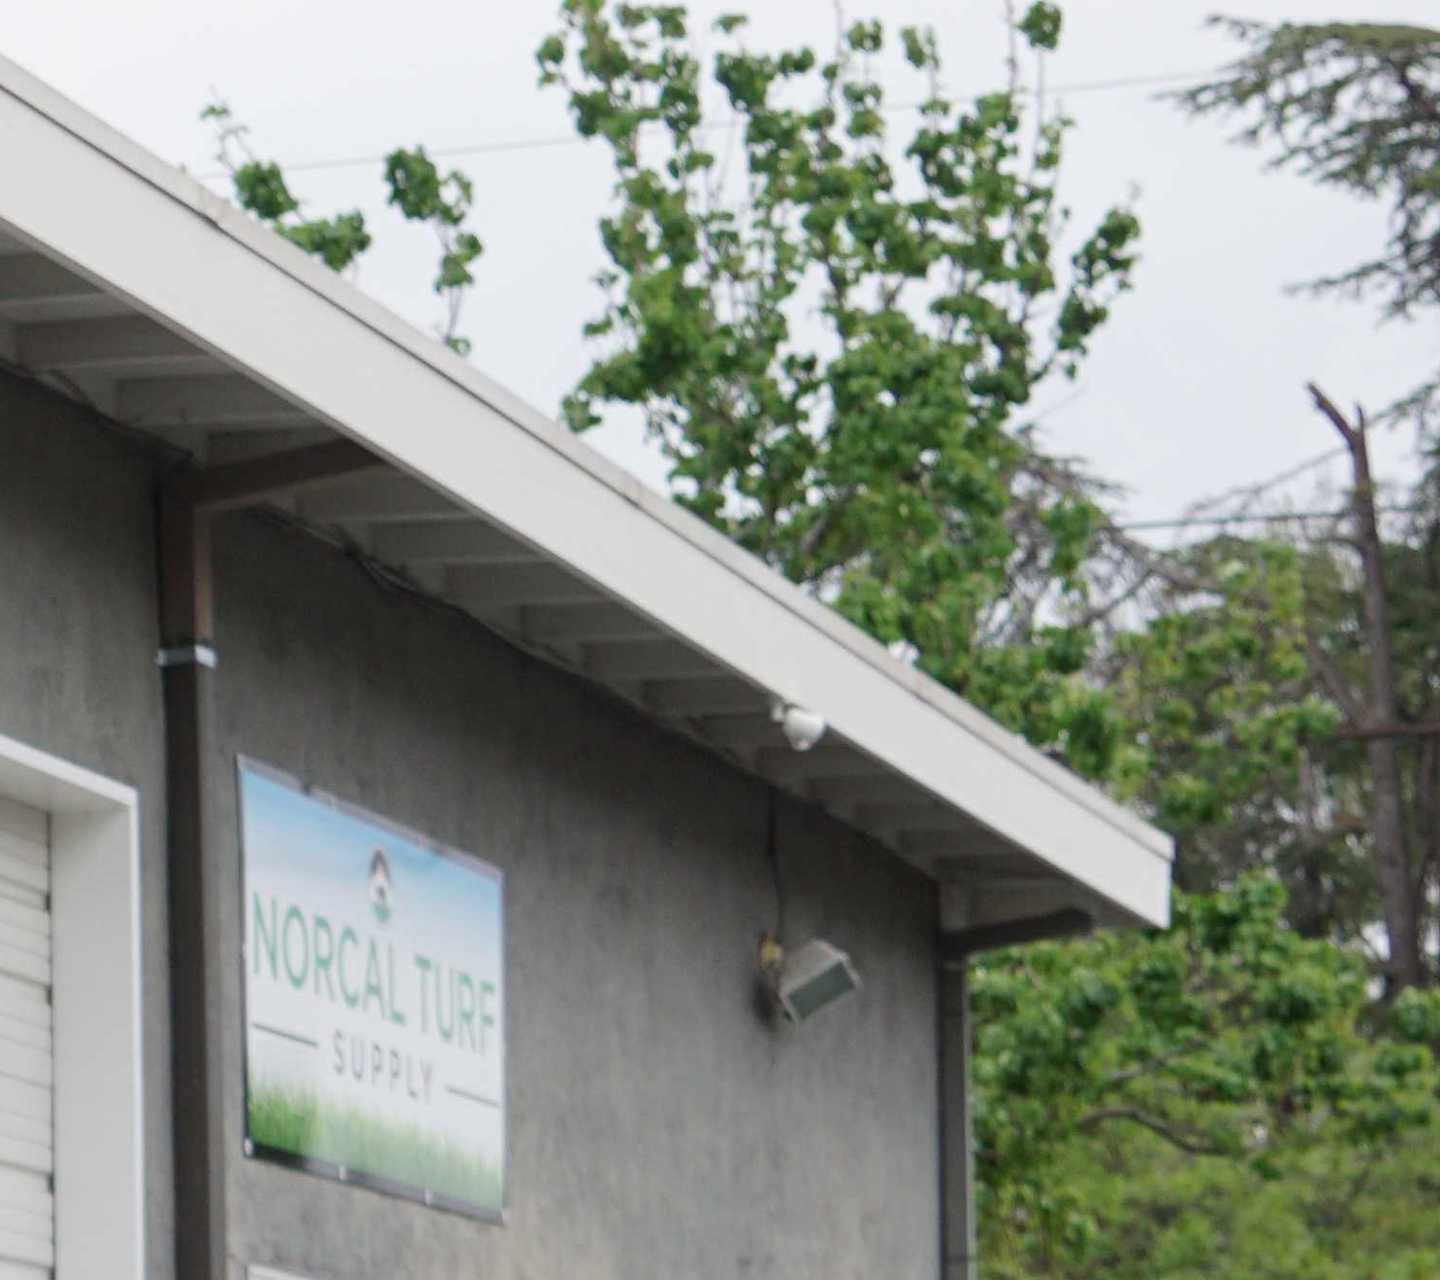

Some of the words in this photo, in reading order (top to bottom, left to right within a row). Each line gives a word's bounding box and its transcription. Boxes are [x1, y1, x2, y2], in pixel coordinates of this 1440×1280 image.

[253, 892, 406, 1026] NORCAL
[414, 954, 496, 1056] TURF
[333, 1029, 435, 1105] SUPPLY
